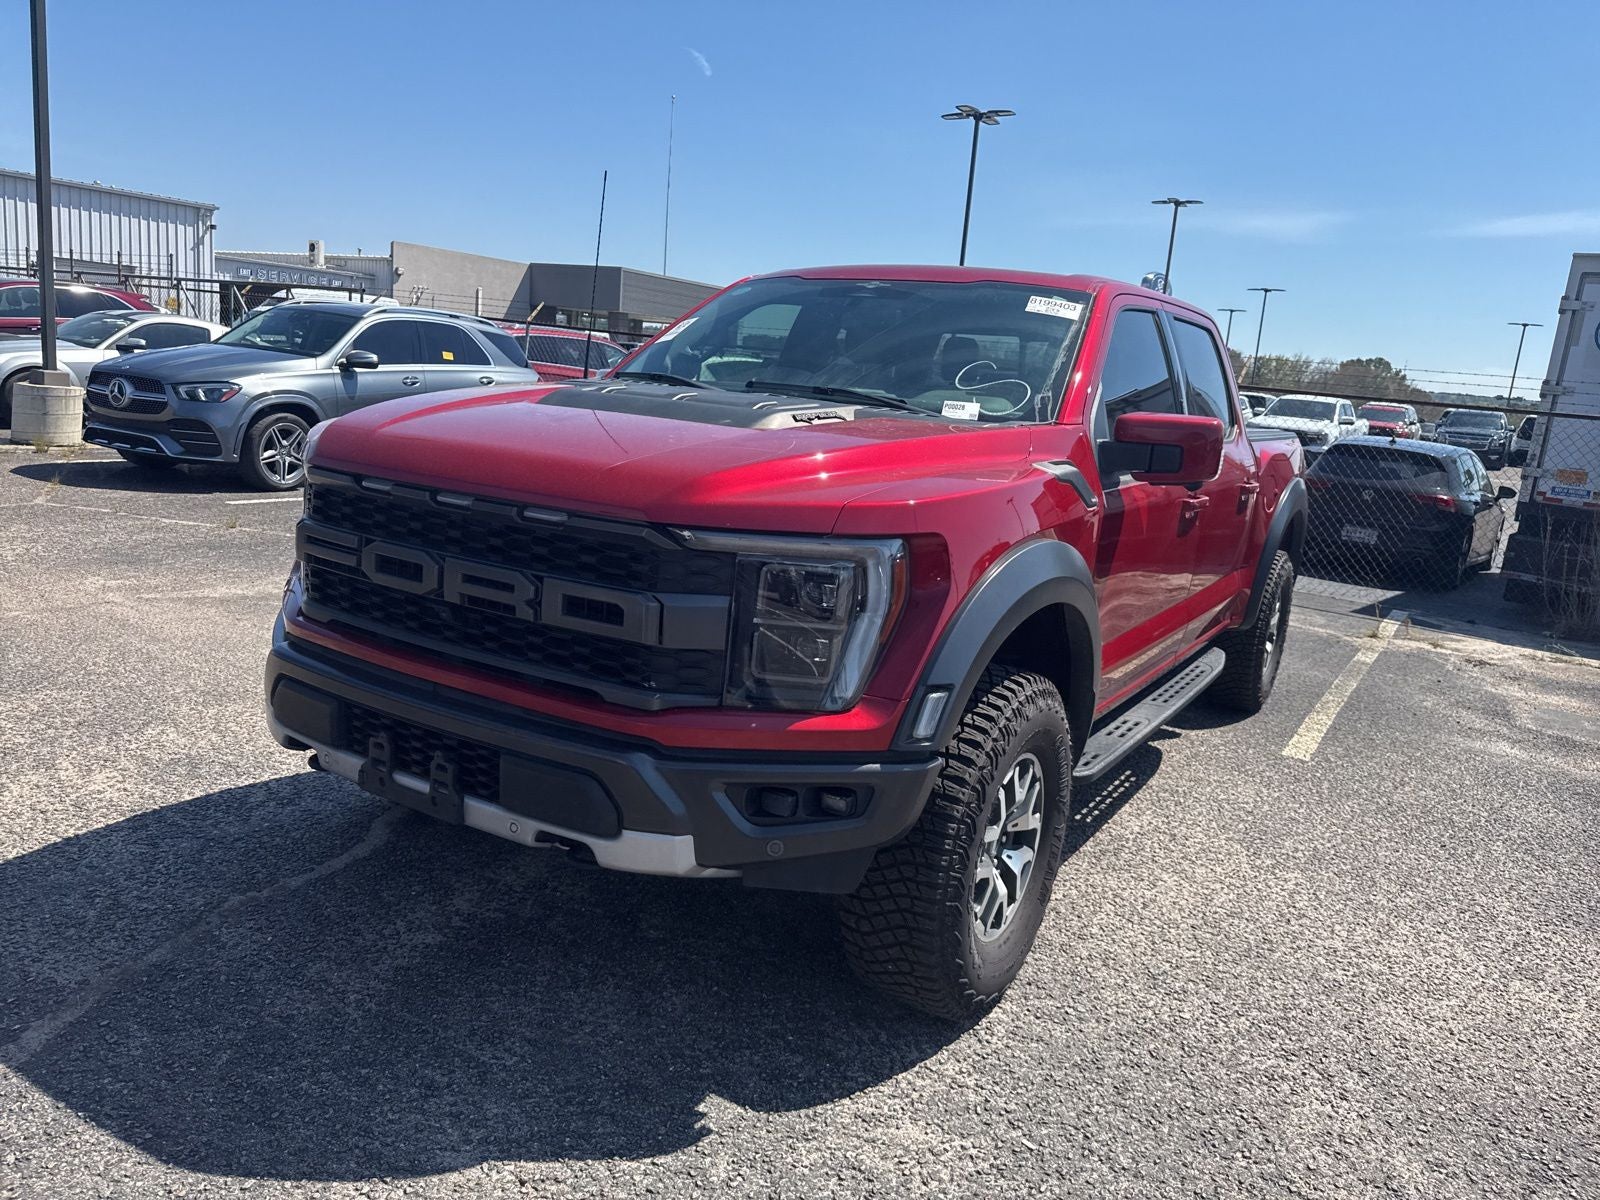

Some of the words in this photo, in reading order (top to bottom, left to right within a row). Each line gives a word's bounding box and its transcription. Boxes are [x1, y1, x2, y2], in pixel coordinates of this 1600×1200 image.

[239, 268, 251, 277] EXIT
[257, 268, 327, 286] SERVICE
[1029, 297, 1077, 312] 8199403
[297, 518, 661, 645] FORD
